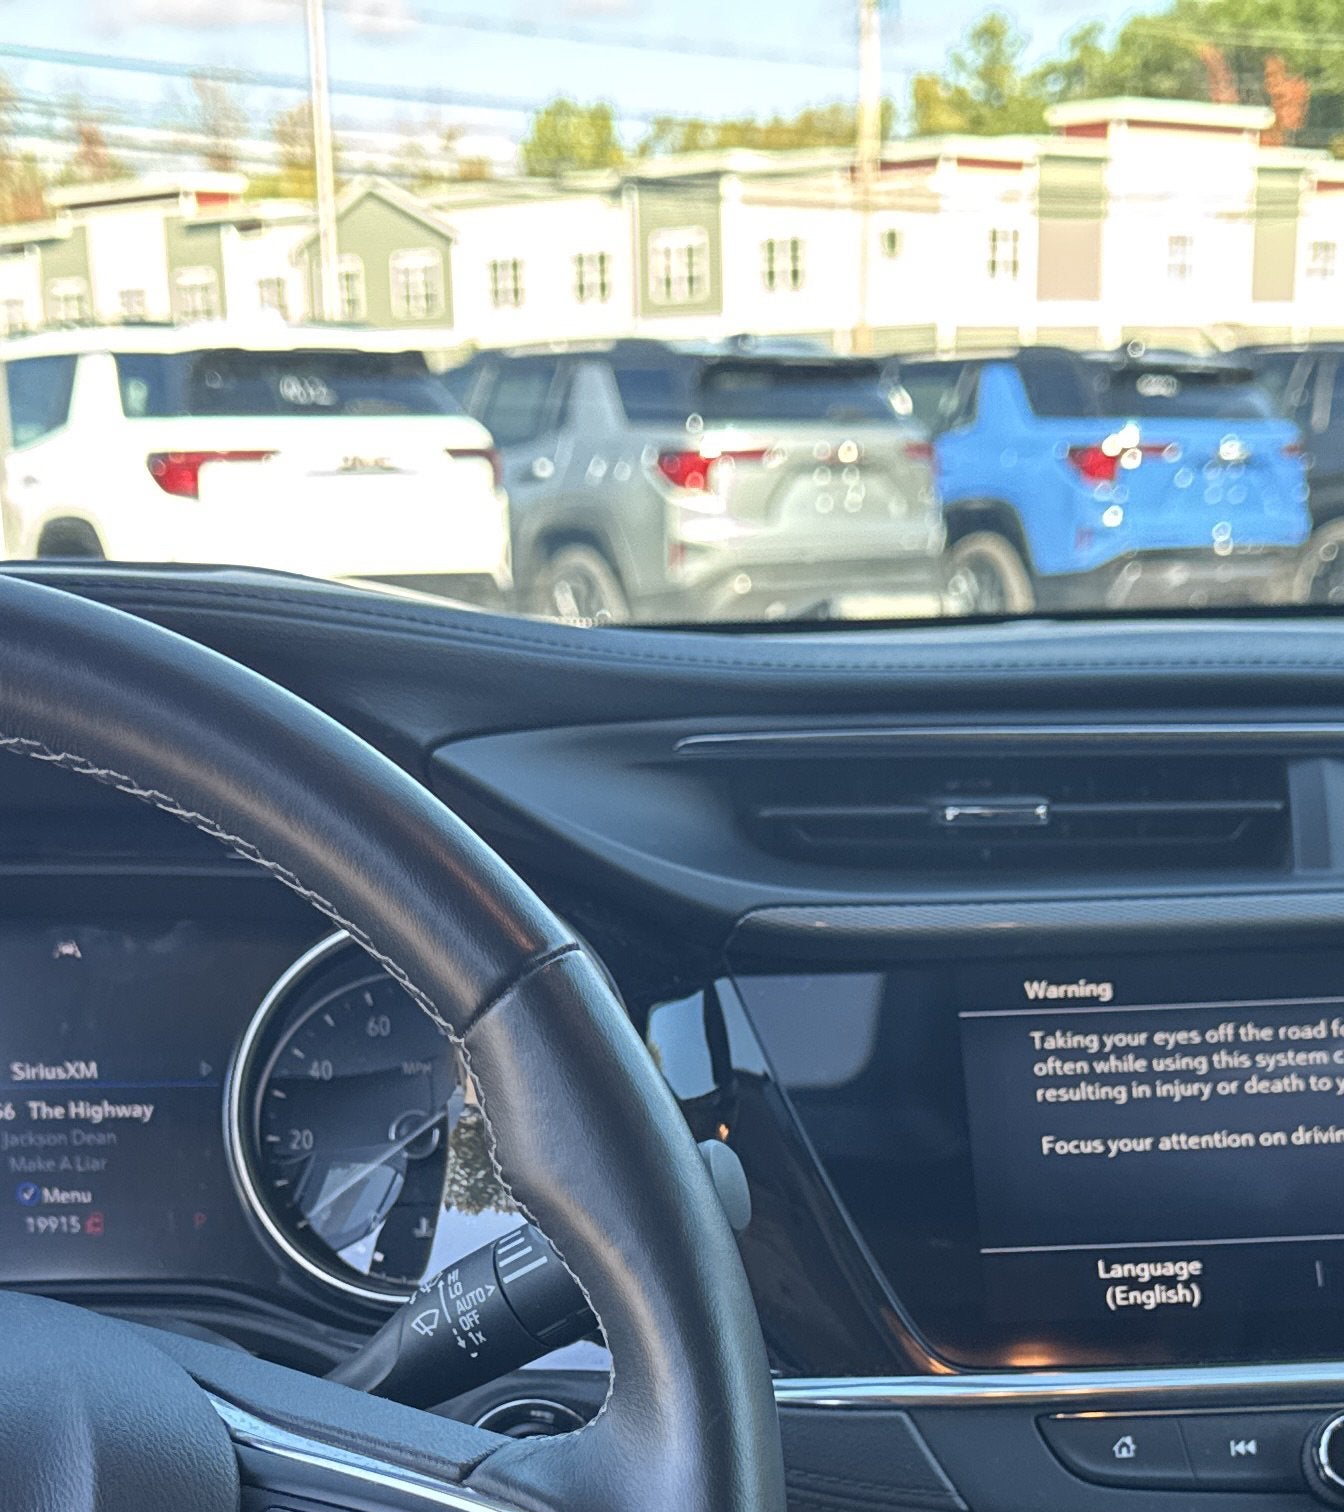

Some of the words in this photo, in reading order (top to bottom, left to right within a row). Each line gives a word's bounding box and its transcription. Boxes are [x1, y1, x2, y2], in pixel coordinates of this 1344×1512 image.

[1024, 979, 1113, 1001] Warning
[366, 1015, 391, 1037] 60
[1029, 1030, 1099, 1053] Taking
[1103, 1031, 1148, 1052] your
[1154, 1029, 1201, 1050] eyes
[1206, 1023, 1235, 1043] off
[1238, 1022, 1273, 1042] the
[1278, 1019, 1327, 1040] road
[10, 1060, 98, 1081] SiriusXM
[309, 1060, 333, 1080] 40
[1034, 1056, 1089, 1077] often
[1093, 1053, 1147, 1074] while
[1152, 1053, 1208, 1075] using
[1213, 1049, 1251, 1070] this
[1256, 1049, 1328, 1071] system
[1037, 1082, 1127, 1104] resulting
[1132, 1081, 1151, 1098] in
[1155, 1079, 1212, 1101] injury
[1216, 1080, 1240, 1095] or
[1244, 1073, 1305, 1094] death
[1309, 1075, 1332, 1092] to
[26, 1101, 64, 1120] The
[68, 1100, 154, 1123] Highway
[1, 1129, 68, 1150] Jackson
[72, 1130, 116, 1145] Dean
[289, 1129, 314, 1150] 20
[1041, 1135, 1105, 1155] Focus
[1107, 1136, 1154, 1158] your
[1158, 1130, 1255, 1151] attention
[1259, 1131, 1287, 1147] on
[10, 1157, 55, 1173] Make
[59, 1156, 74, 1171] A
[76, 1156, 107, 1172] Liar
[41, 1187, 92, 1204] Menu
[25, 1215, 82, 1234] 19915
[448, 1269, 459, 1285] HI
[1097, 1258, 1203, 1280] Language
[448, 1282, 463, 1299] LO
[1105, 1283, 1201, 1310] (English)
[456, 1288, 486, 1315] AUTO
[458, 1310, 480, 1331] OFF
